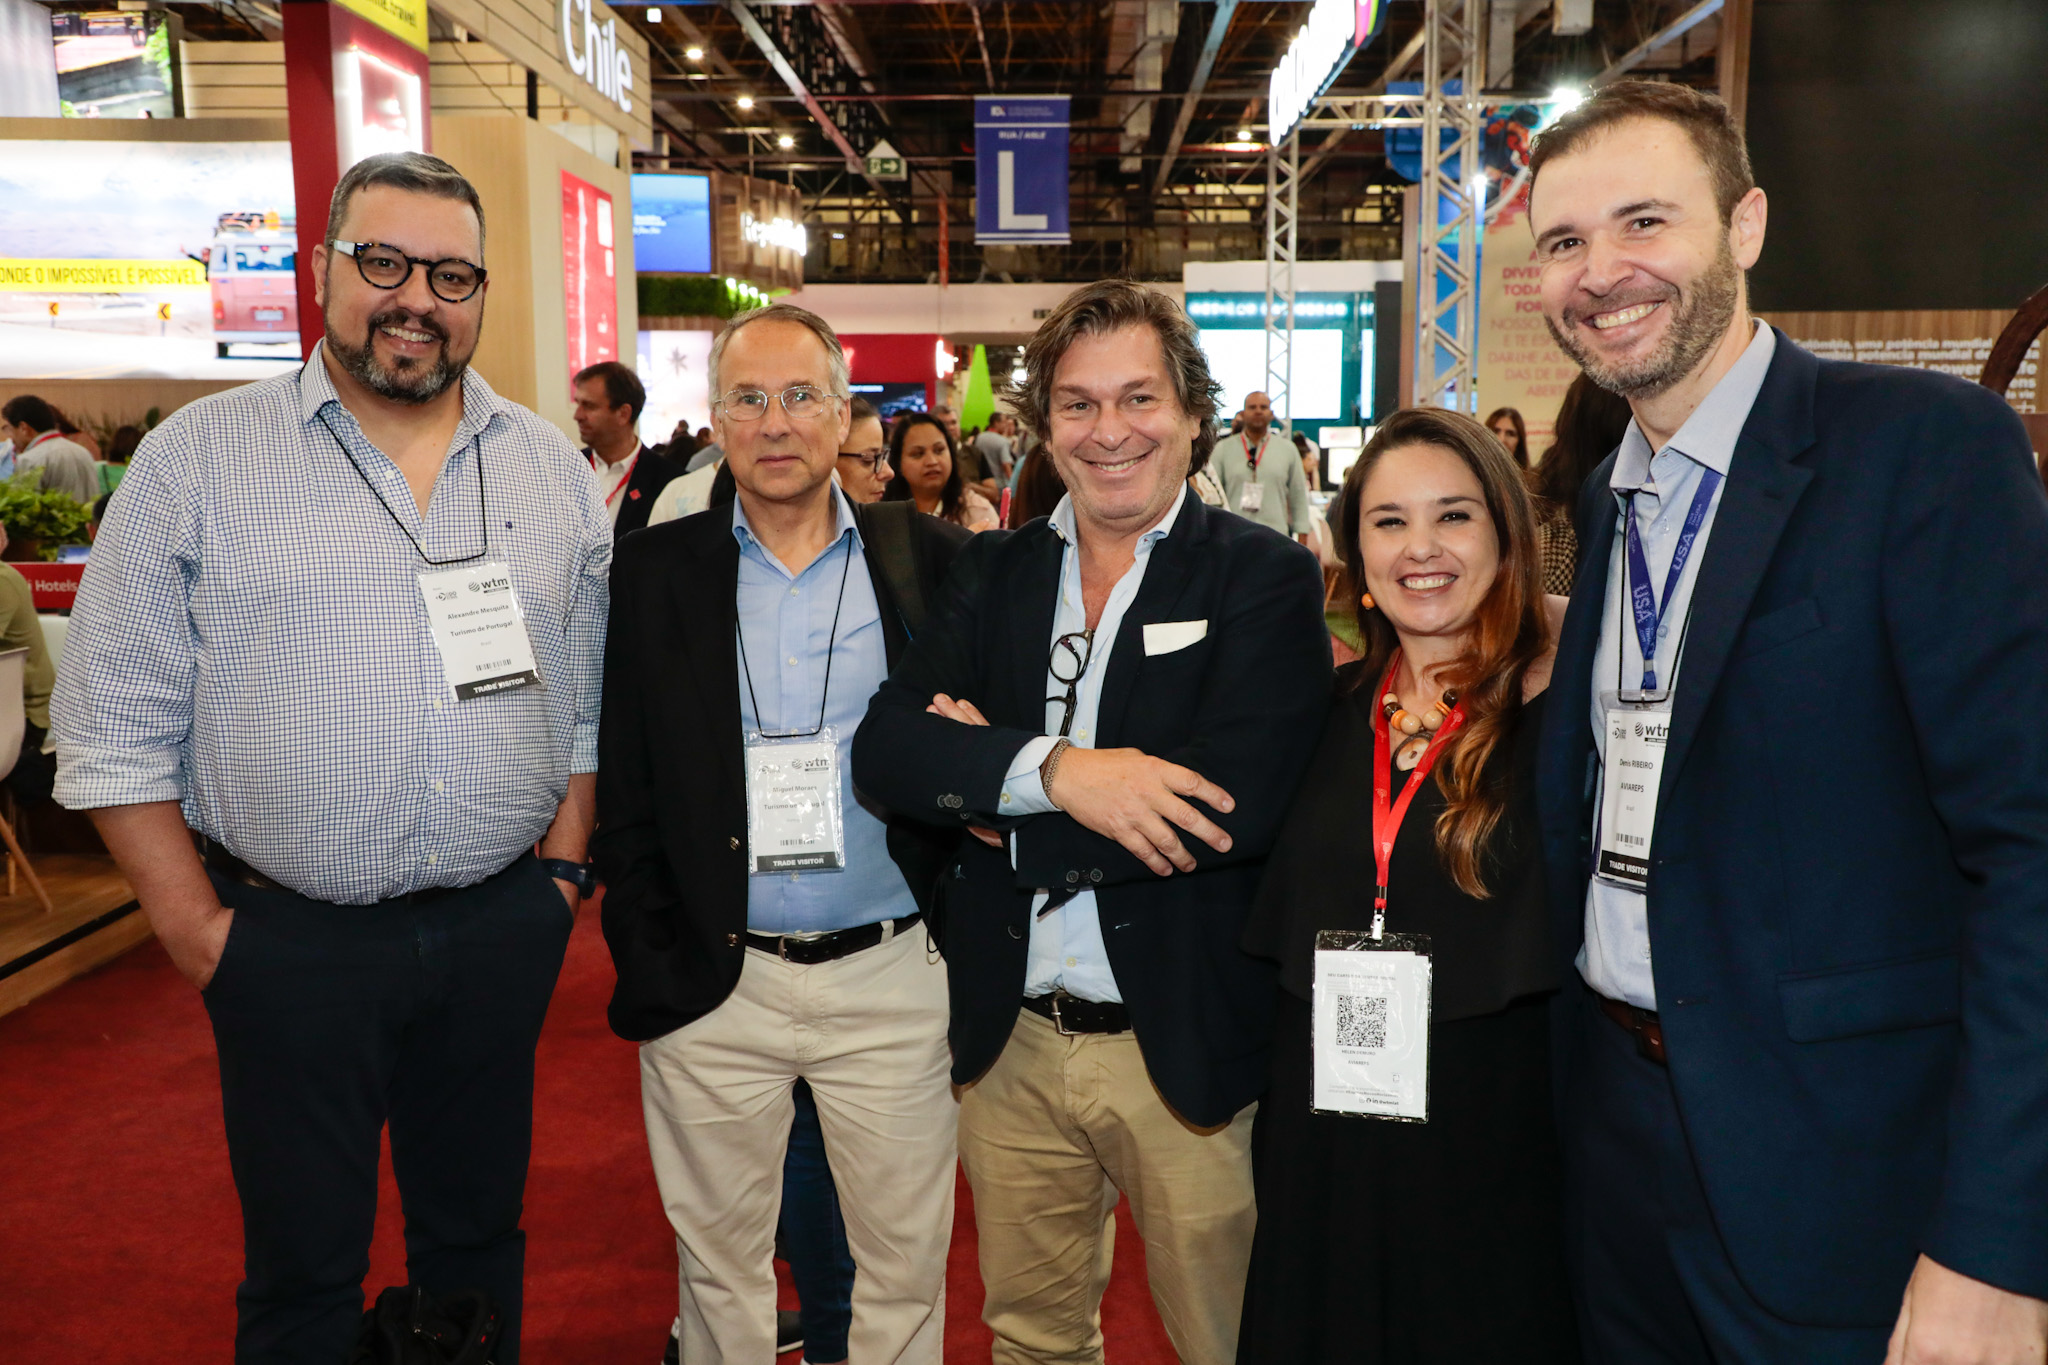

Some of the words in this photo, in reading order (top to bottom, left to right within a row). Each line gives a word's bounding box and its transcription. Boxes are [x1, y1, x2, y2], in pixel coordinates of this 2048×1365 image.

[562, 0, 633, 113] Chile
[998, 150, 1048, 230] L
[0, 266, 32, 284] ONDE
[35, 267, 44, 284] O
[47, 264, 124, 285] IMPOSSÍVEL
[1941, 338, 1993, 349] mundial
[1917, 349, 1973, 360] mundial
[1672, 532, 1695, 571] USA
[34, 579, 79, 592] Hotels
[481, 577, 509, 590] wtm
[1633, 584, 1651, 624] USA
[447, 609, 480, 621] Alexandre
[480, 604, 510, 614] Mesquita
[450, 627, 477, 637] Turismo
[486, 620, 513, 631] Portugal
[473, 682, 497, 694] TRADE
[498, 677, 526, 689] VISITOR
[1619, 758, 1632, 767] Denis
[1632, 760, 1654, 770] RIBEIRO
[1620, 782, 1644, 793] AVIAREPS
[797, 858, 824, 866] VISITOR
[1609, 860, 1626, 871] TRADE
